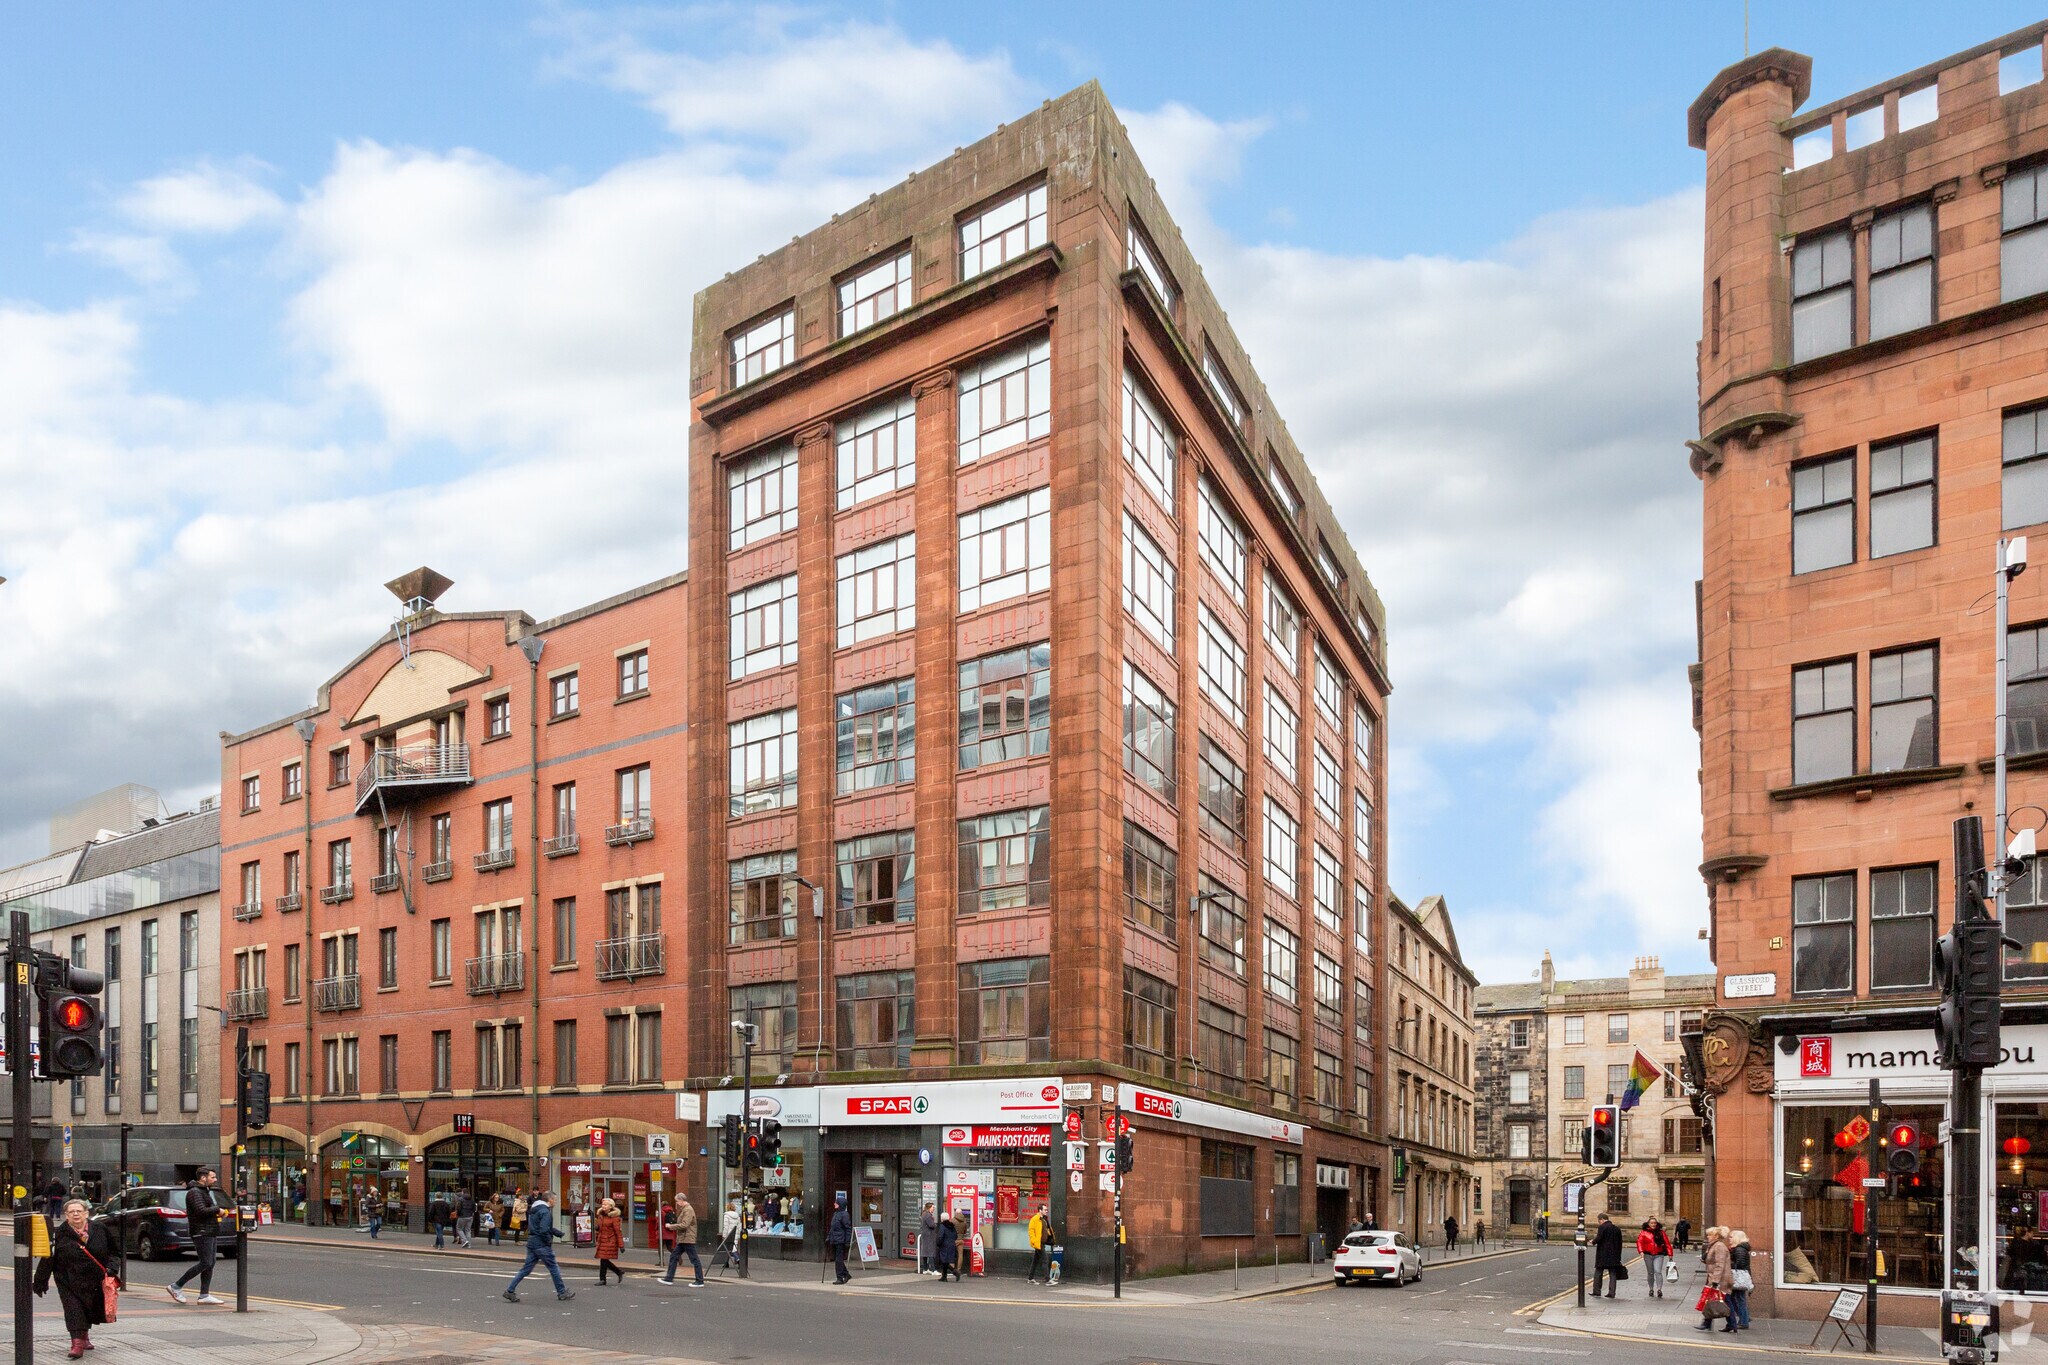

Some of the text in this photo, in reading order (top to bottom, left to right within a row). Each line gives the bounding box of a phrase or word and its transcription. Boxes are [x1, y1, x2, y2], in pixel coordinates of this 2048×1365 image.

[1729, 976, 1770, 985] GLASSFORD
[1736, 984, 1763, 992] STREET
[1805, 1040, 1827, 1073] 商城
[1000, 1091, 1034, 1099] Post Office
[860, 1099, 911, 1112] SPAR
[1143, 1097, 1173, 1114] SPAR
[1048, 1112, 1060, 1121] City
[977, 1134, 1050, 1147] MAINS POST OFFICE
[768, 1178, 787, 1186] SALE
[950, 1186, 976, 1194] Free Cash
